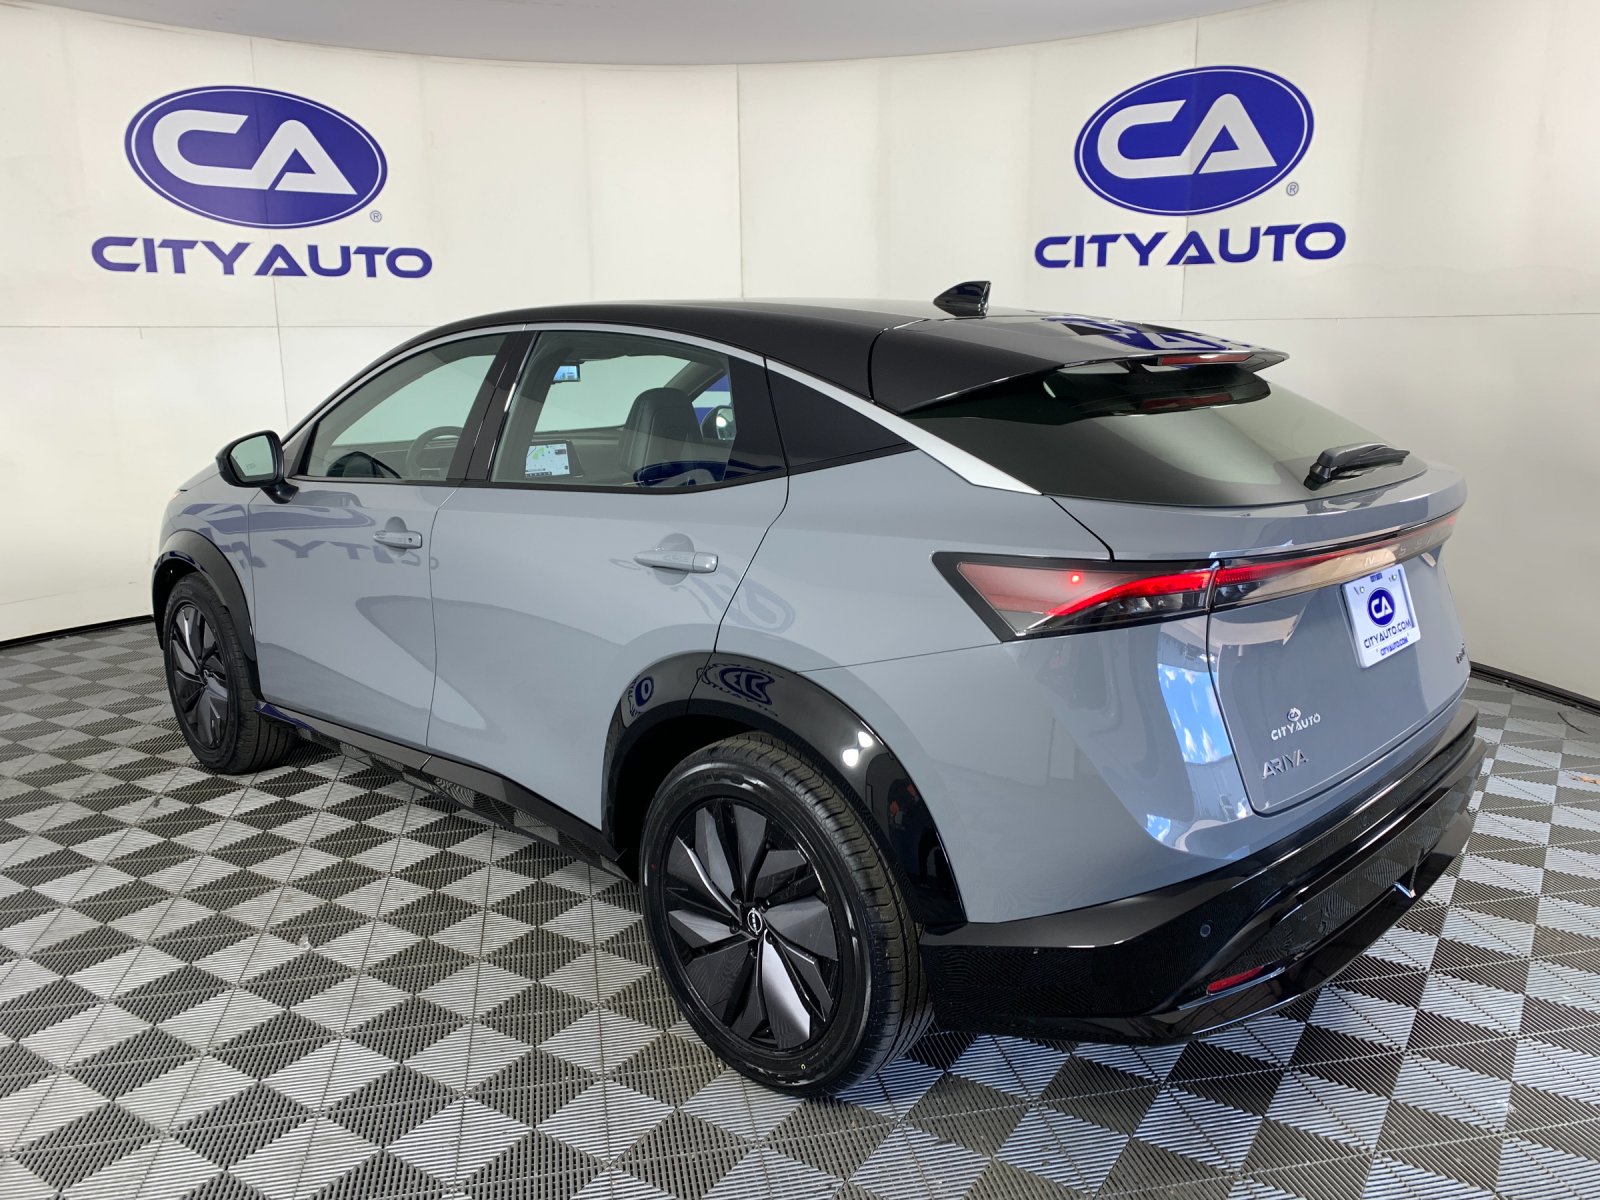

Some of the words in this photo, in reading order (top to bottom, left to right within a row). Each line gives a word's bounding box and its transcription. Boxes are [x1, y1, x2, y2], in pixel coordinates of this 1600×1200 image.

[152, 109, 358, 195] CA
[1097, 93, 1278, 179] CA
[91, 236, 255, 275] CITY
[254, 243, 433, 279] AUTO
[1034, 231, 1168, 269] CITY
[1167, 221, 1347, 265] AUTO
[1371, 596, 1394, 619] CA
[1262, 749, 1309, 779] ARIYA
